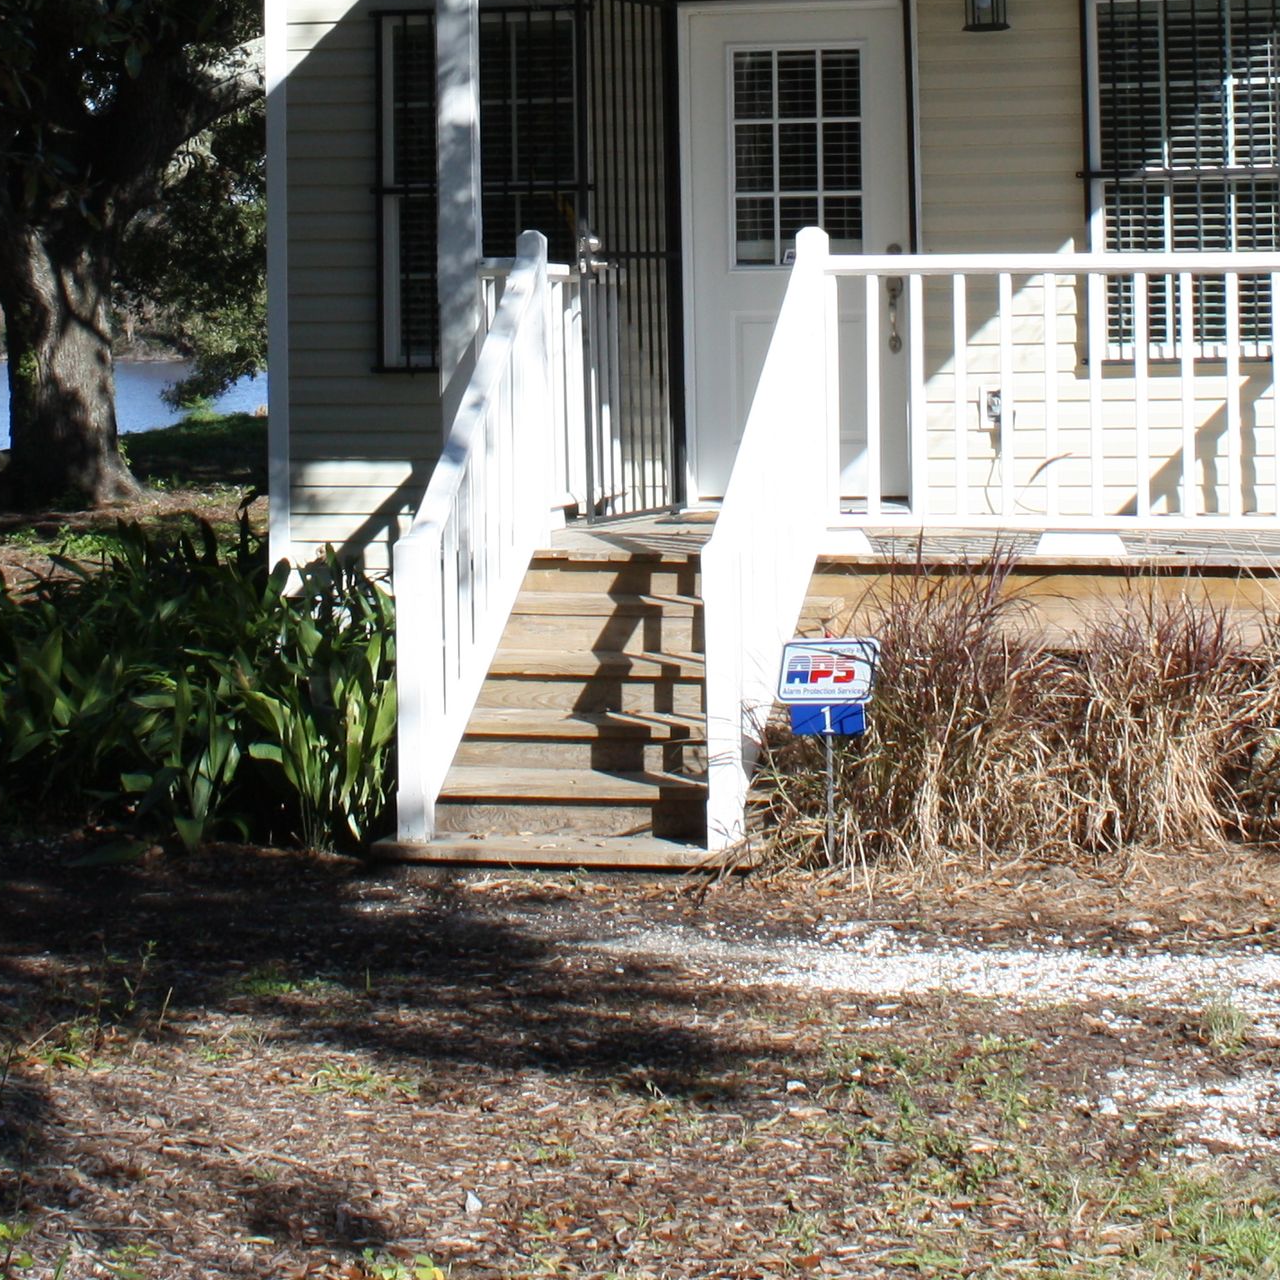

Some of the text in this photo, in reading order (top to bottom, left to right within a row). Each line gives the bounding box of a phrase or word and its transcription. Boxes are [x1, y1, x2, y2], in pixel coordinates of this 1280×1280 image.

[786, 655, 856, 684] APS
[782, 687, 864, 695] Alarm Protection Services
[821, 705, 835, 733] 1
